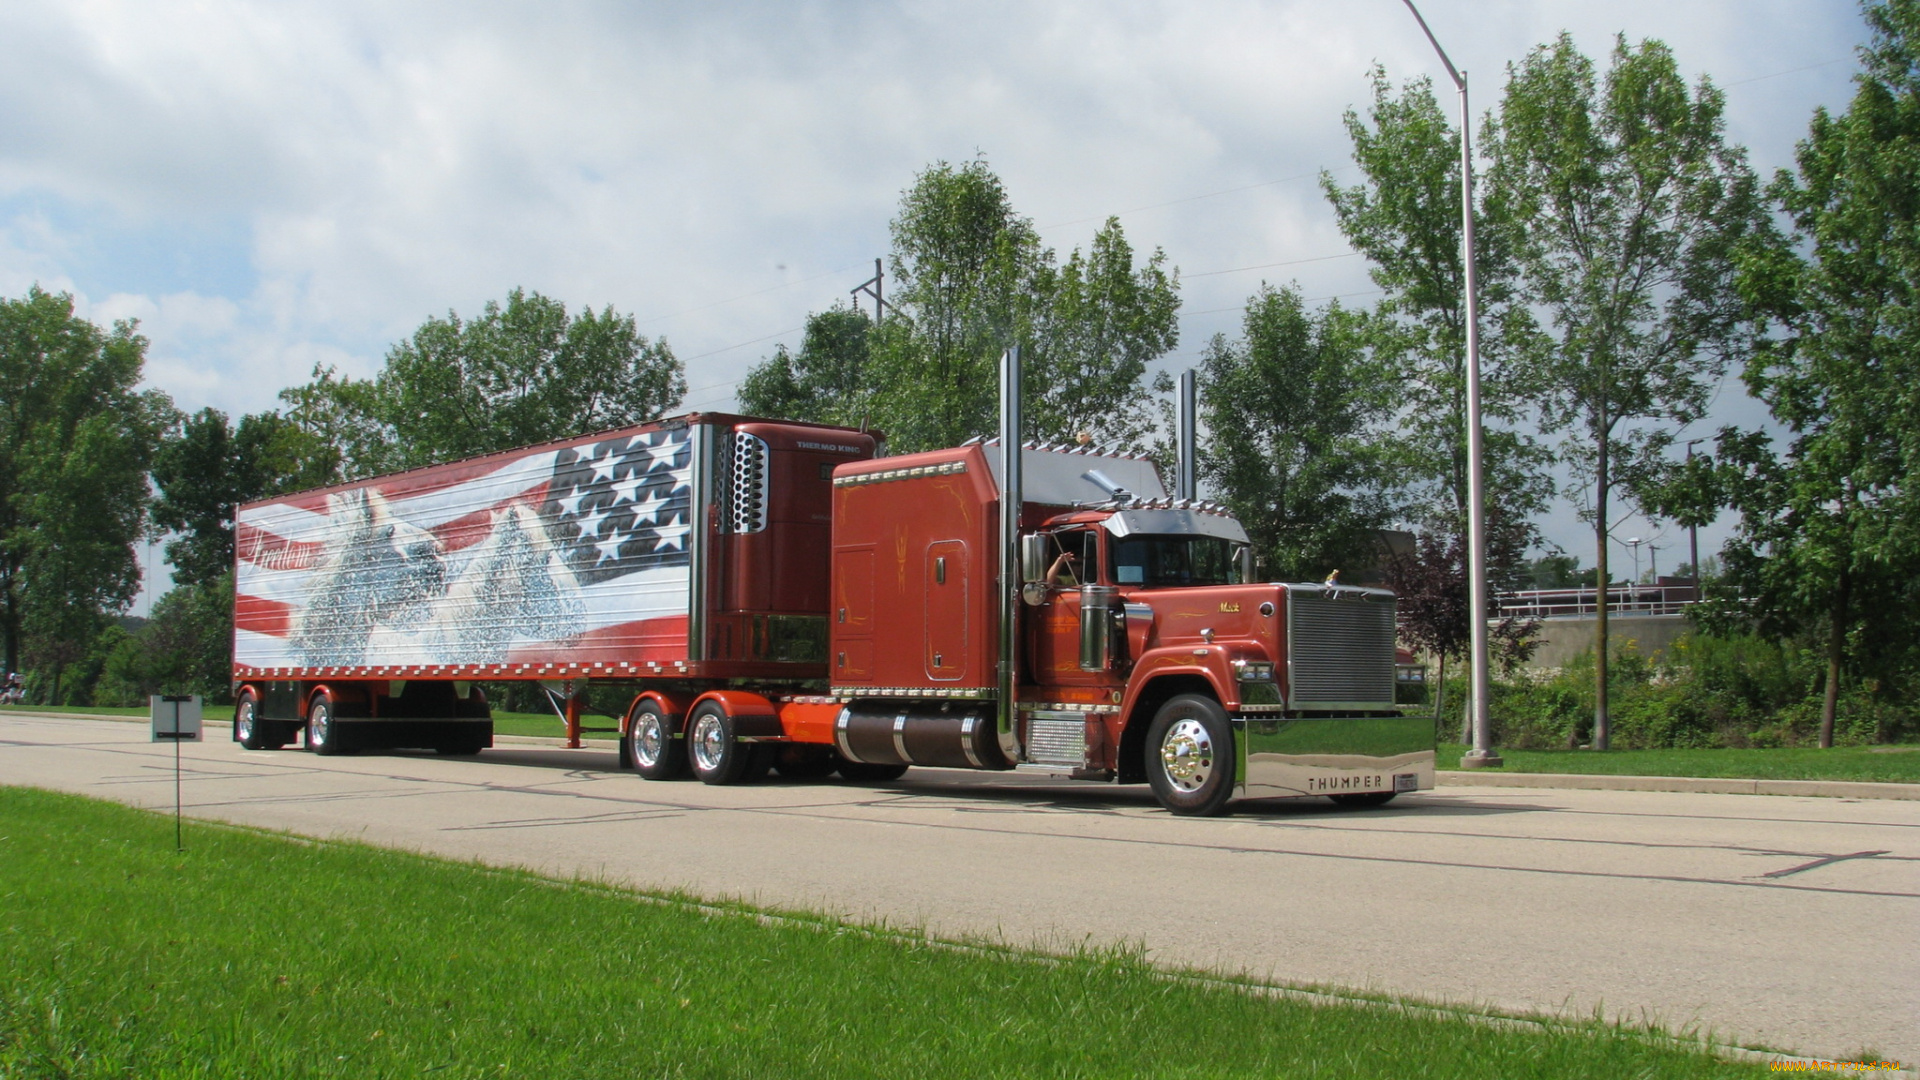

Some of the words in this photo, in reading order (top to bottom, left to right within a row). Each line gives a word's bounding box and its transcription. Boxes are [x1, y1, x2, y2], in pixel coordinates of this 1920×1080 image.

[796, 440, 837, 452] THERMO
[838, 445, 861, 454] KING
[246, 521, 312, 575] Freedom
[1308, 775, 1382, 791] THUMPER
